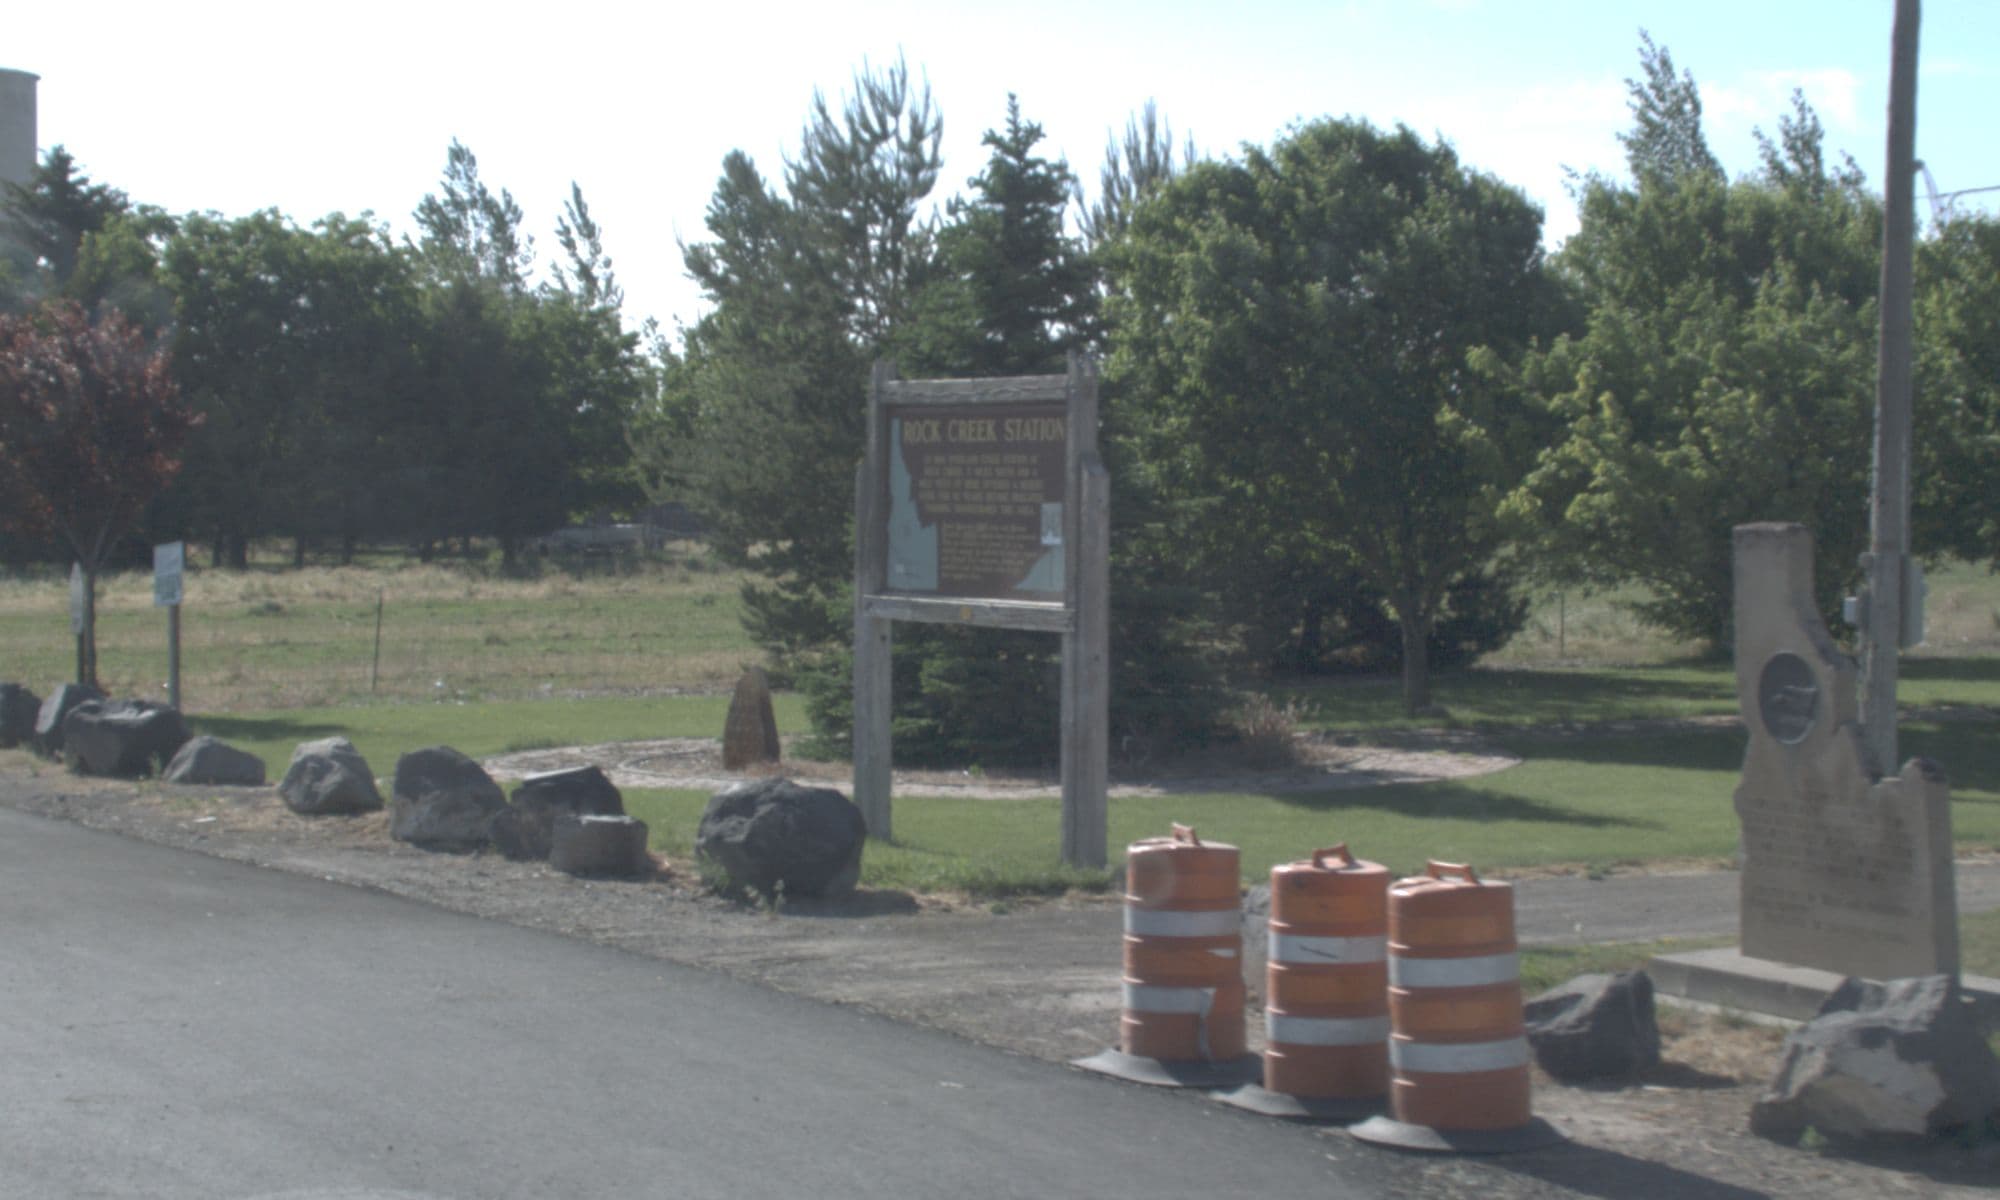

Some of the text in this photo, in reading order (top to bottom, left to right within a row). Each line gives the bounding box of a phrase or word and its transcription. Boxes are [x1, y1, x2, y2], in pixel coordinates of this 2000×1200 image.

[903, 416, 1066, 442] ROCK CREEK STATION
